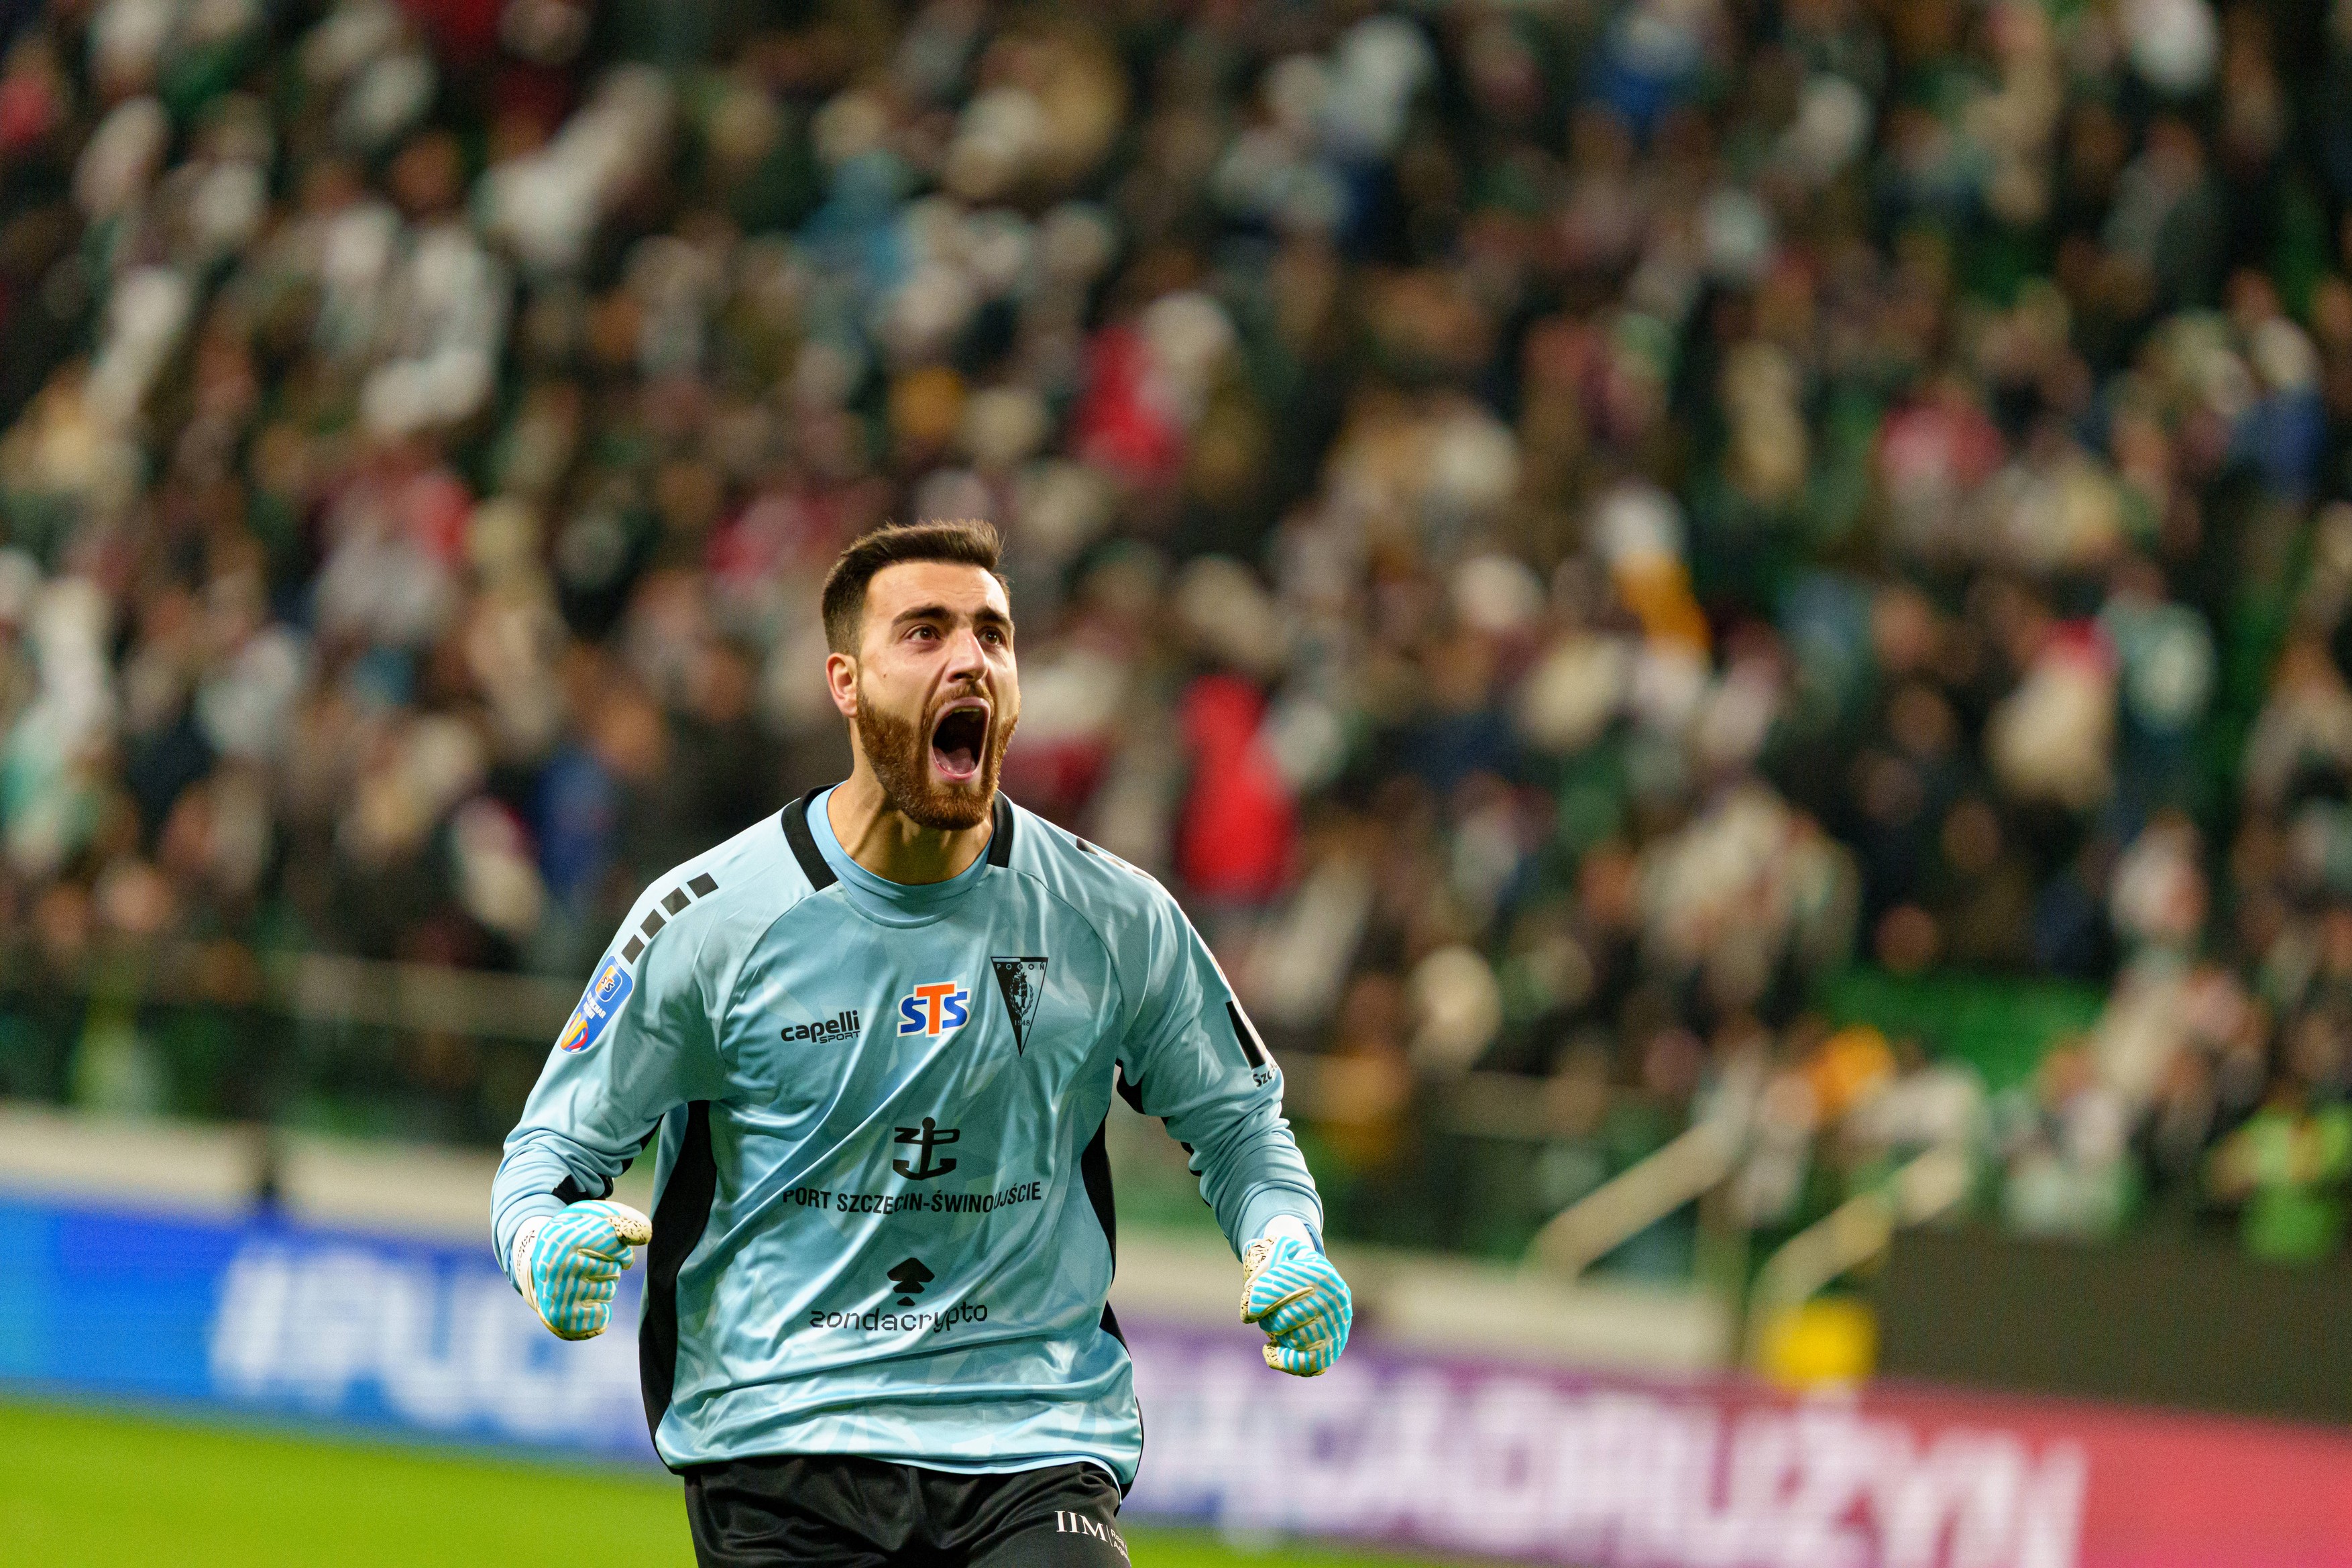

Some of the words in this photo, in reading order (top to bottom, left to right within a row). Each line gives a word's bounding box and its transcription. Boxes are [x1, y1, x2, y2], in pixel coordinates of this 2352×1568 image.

[997, 962, 1044, 970] POGOŃ
[897, 981, 970, 1037] STS
[781, 1010, 860, 1044] capelli
[820, 1031, 860, 1044] SPORT
[783, 1188, 832, 1210] PORT
[837, 1181, 1042, 1215] SZCZECIN-ŚWINOUJŚCIE
[809, 1300, 988, 1333] zondacrypto
[1054, 1510, 1109, 1543] IIM
